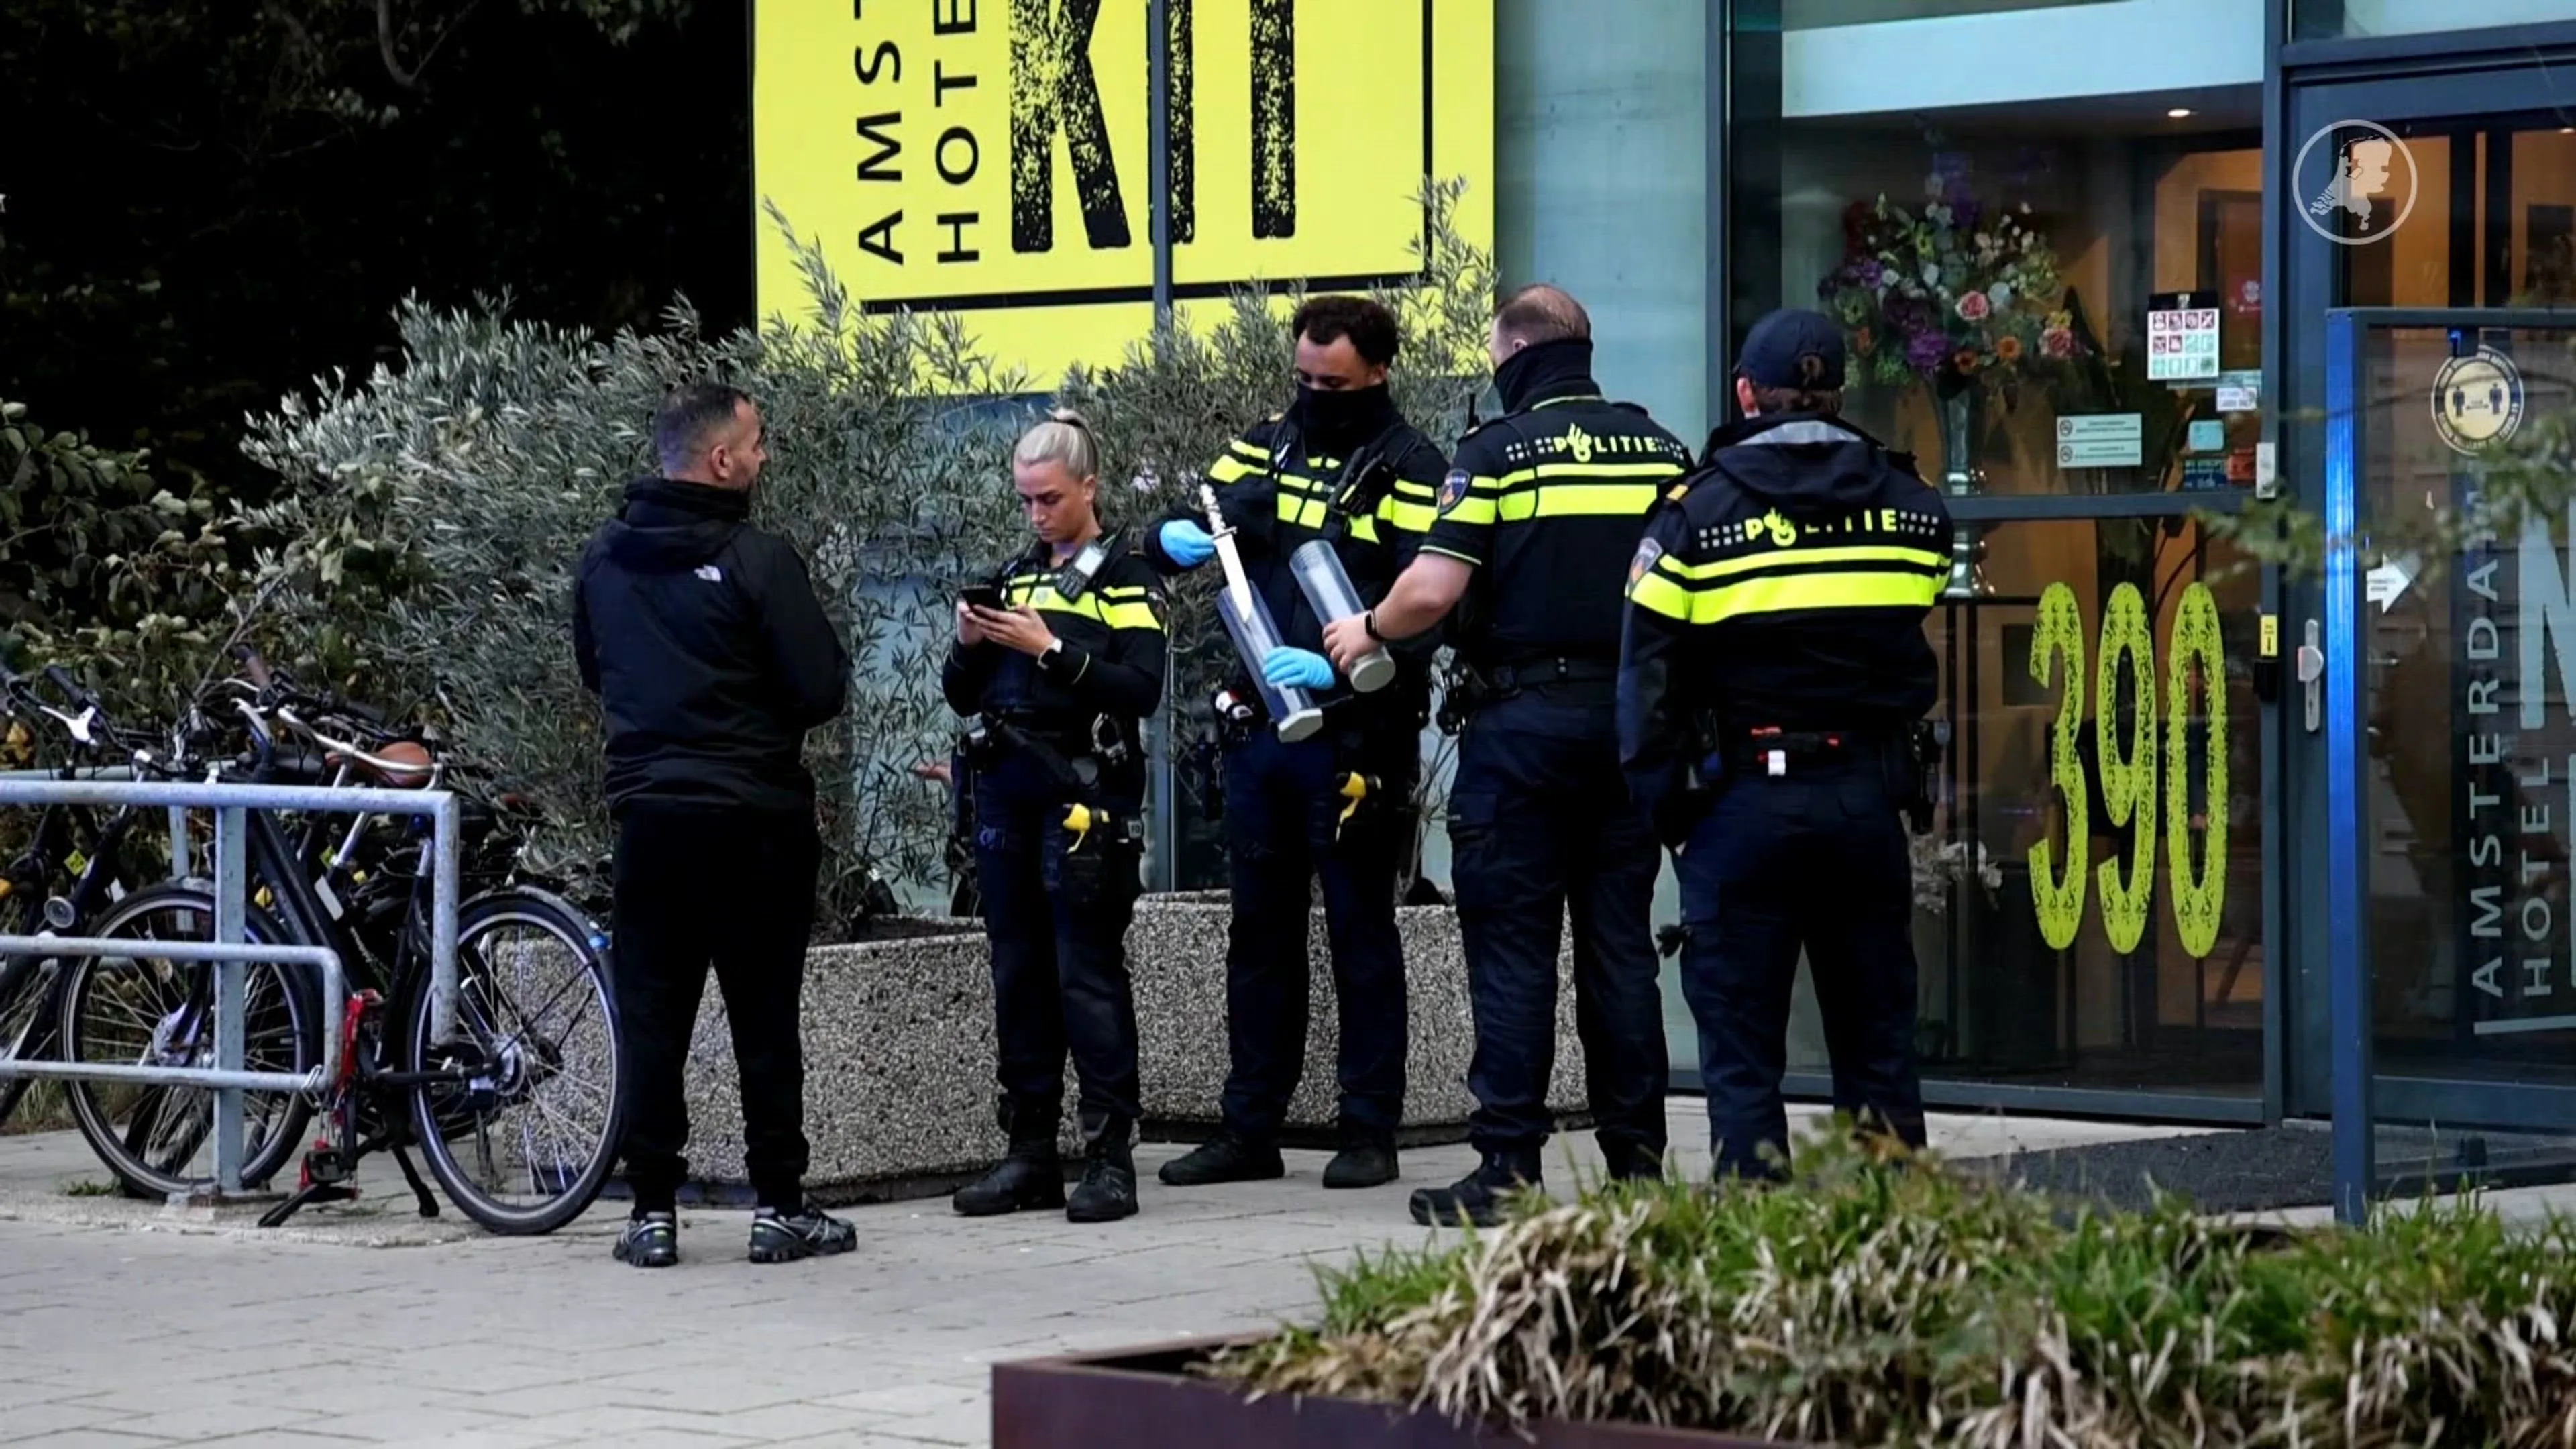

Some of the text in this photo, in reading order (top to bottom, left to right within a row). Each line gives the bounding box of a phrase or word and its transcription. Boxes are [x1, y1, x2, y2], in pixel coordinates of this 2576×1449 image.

[1743, 508, 1898, 546] POIE
[2027, 581, 2229, 959] 390
[2467, 491, 2504, 998] AMSTERDA
[2520, 757, 2553, 997] HOTEL
